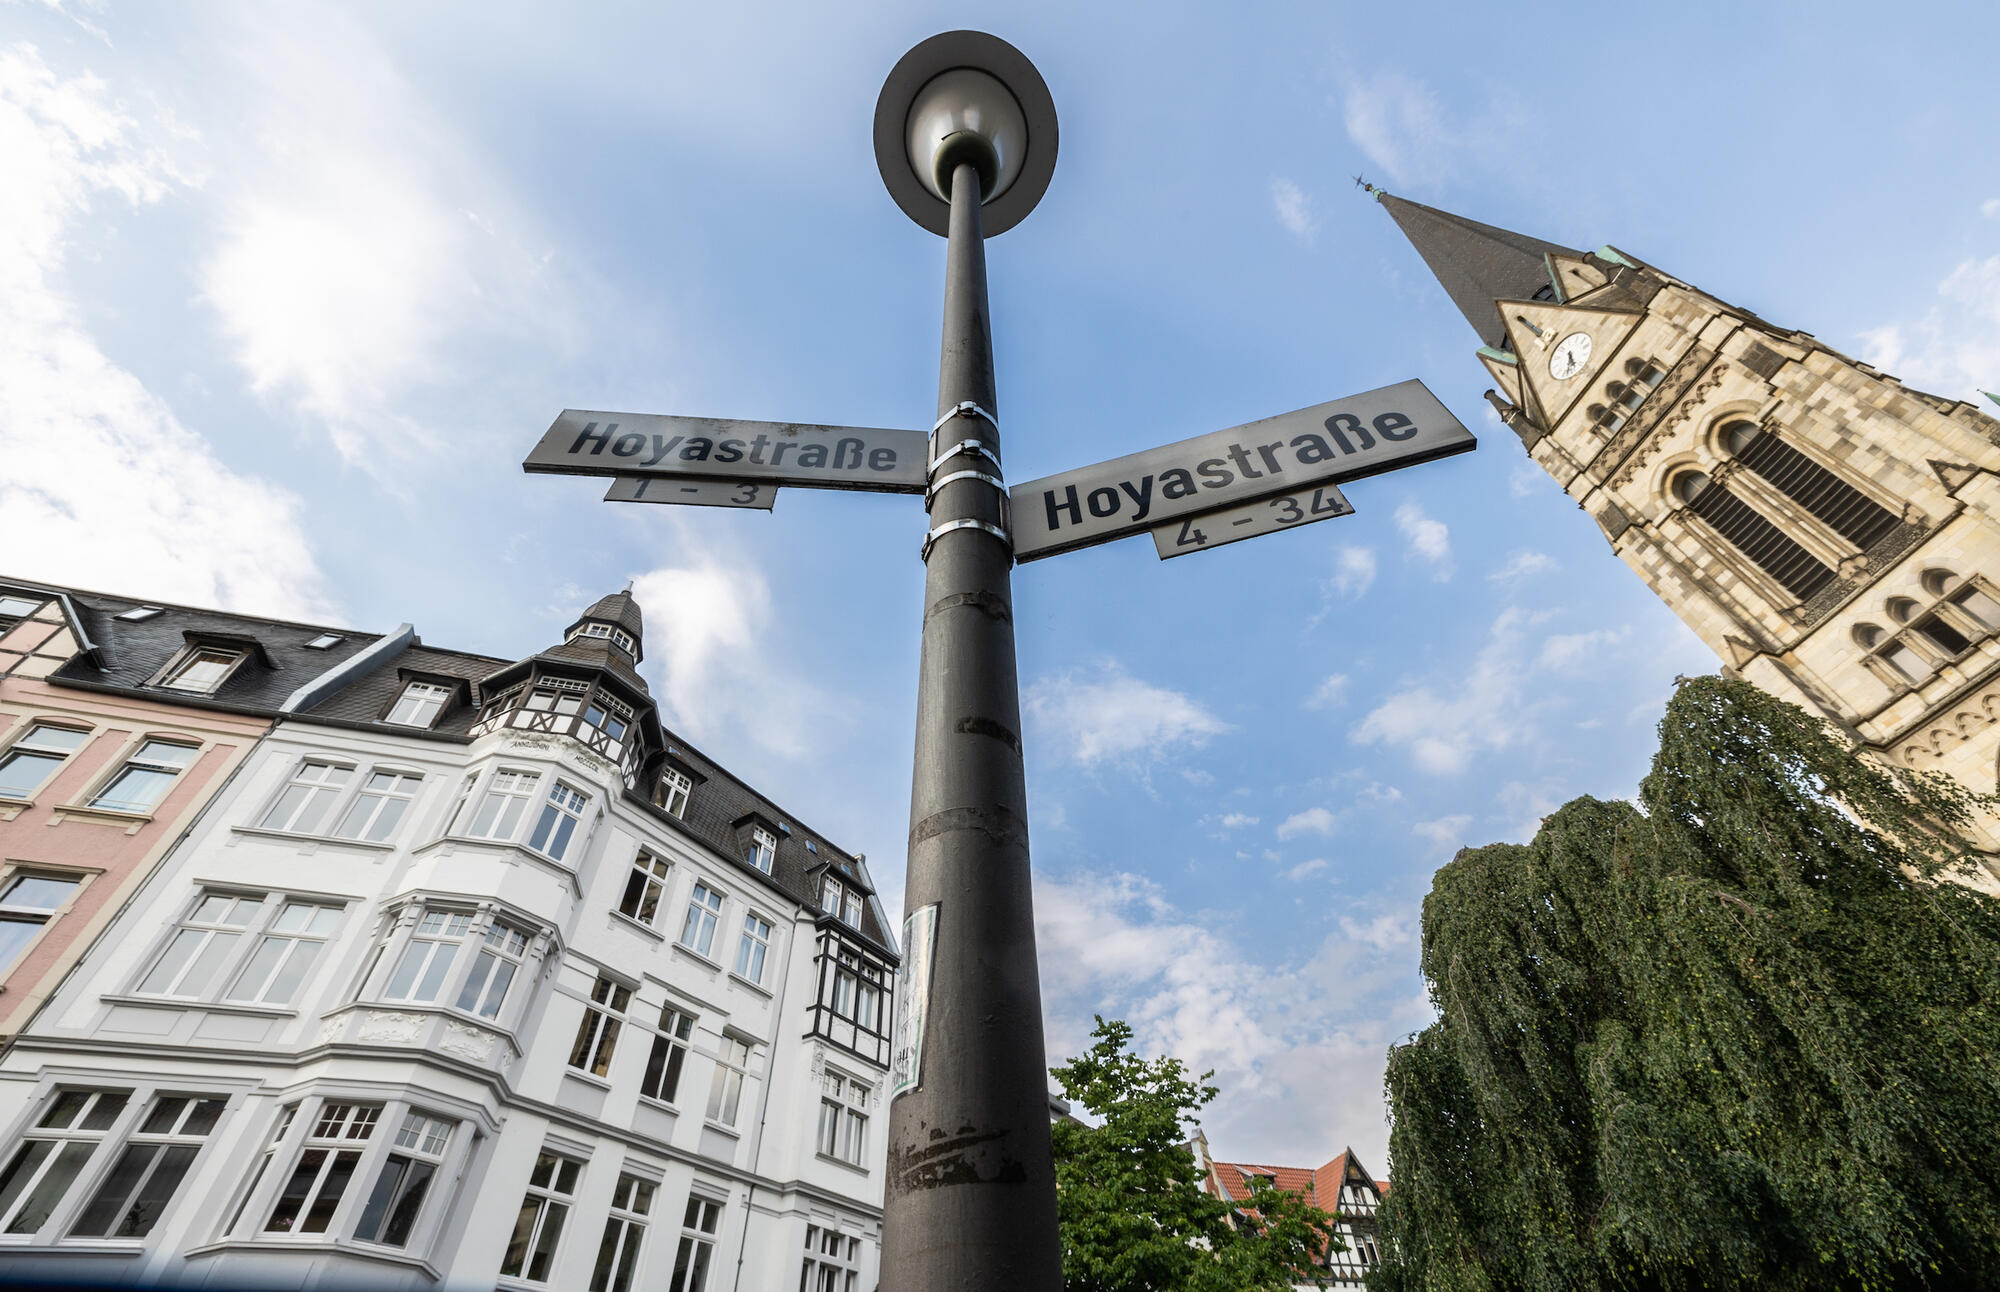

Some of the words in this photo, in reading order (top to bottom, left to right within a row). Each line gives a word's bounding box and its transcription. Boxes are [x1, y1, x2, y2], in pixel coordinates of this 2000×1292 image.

[568, 421, 897, 472] Hoyastraße
[1043, 411, 1418, 531] Hoyastraße
[633, 479, 650, 499] 1
[731, 482, 760, 505] 3
[1176, 519, 1207, 547] 4
[1269, 489, 1343, 524] 34
